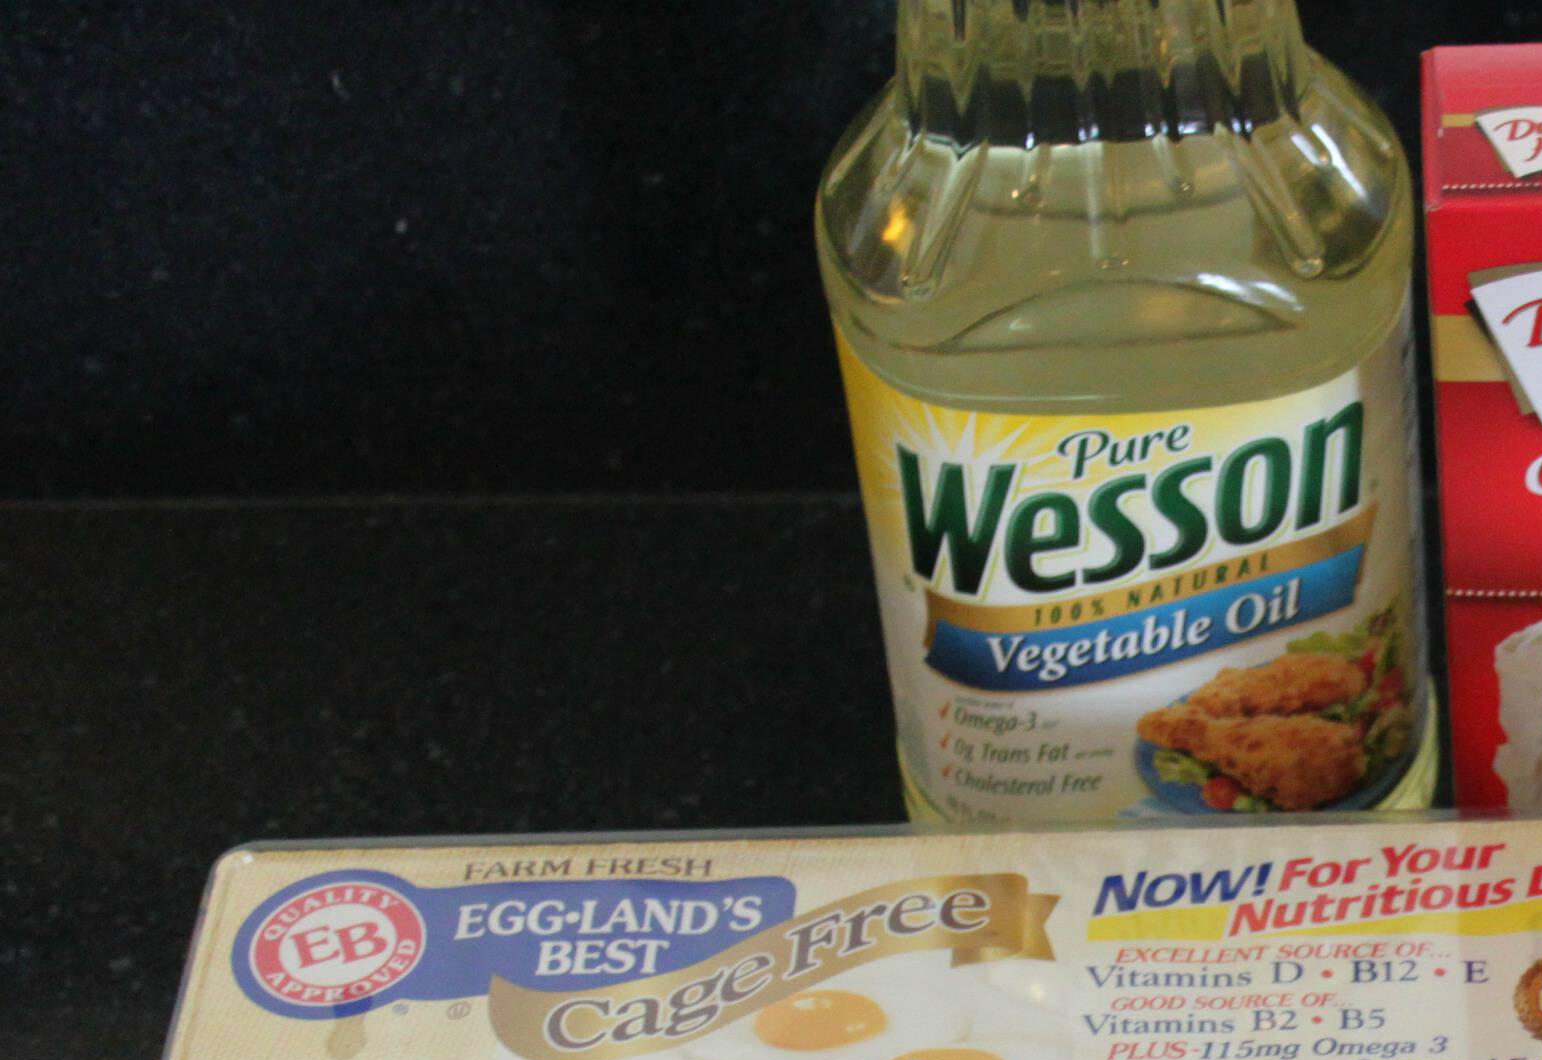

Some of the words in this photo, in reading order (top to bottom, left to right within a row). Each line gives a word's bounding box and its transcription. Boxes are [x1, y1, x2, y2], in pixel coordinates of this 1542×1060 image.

[1057, 424, 1192, 480] Pure
[895, 399, 1366, 598] Wesson
[1032, 599, 1107, 628] 100%
[1125, 553, 1272, 607] NATURAL
[985, 612, 1213, 683] Vegetable
[1224, 576, 1301, 636] Oil
[1036, 743, 1071, 764] Fat
[1061, 773, 1104, 794] Free
[462, 858, 573, 881] FARM
[586, 856, 714, 879] FRESH
[1092, 861, 1274, 917] NOW!
[1278, 854, 1366, 893] For
[1380, 840, 1508, 876] Your
[263, 887, 402, 942] QUALITY
[1228, 876, 1515, 938] Nutritious
[265, 937, 419, 1002] APPROVED
[289, 920, 389, 969] EB
[532, 938, 671, 978] BEST
[541, 950, 774, 1054] Cage
[780, 884, 995, 982] Free
[1115, 944, 1272, 964] EXCELLENT
[1275, 941, 1388, 961] SOURCE
[1085, 964, 1254, 989] Vitamins
[1270, 960, 1305, 985] D
[1350, 959, 1420, 985] B12
[1463, 959, 1491, 984] E
[1082, 1012, 1236, 1036] Vitamins
[1252, 1008, 1299, 1032] B2
[1339, 1007, 1387, 1031] B5
[1110, 994, 1187, 1013] GOOD
[1191, 992, 1295, 1011] SOURCE
[1199, 1040, 1303, 1060] 115mg
[1312, 1036, 1416, 1058] Omega
[1427, 1035, 1450, 1054] 3
